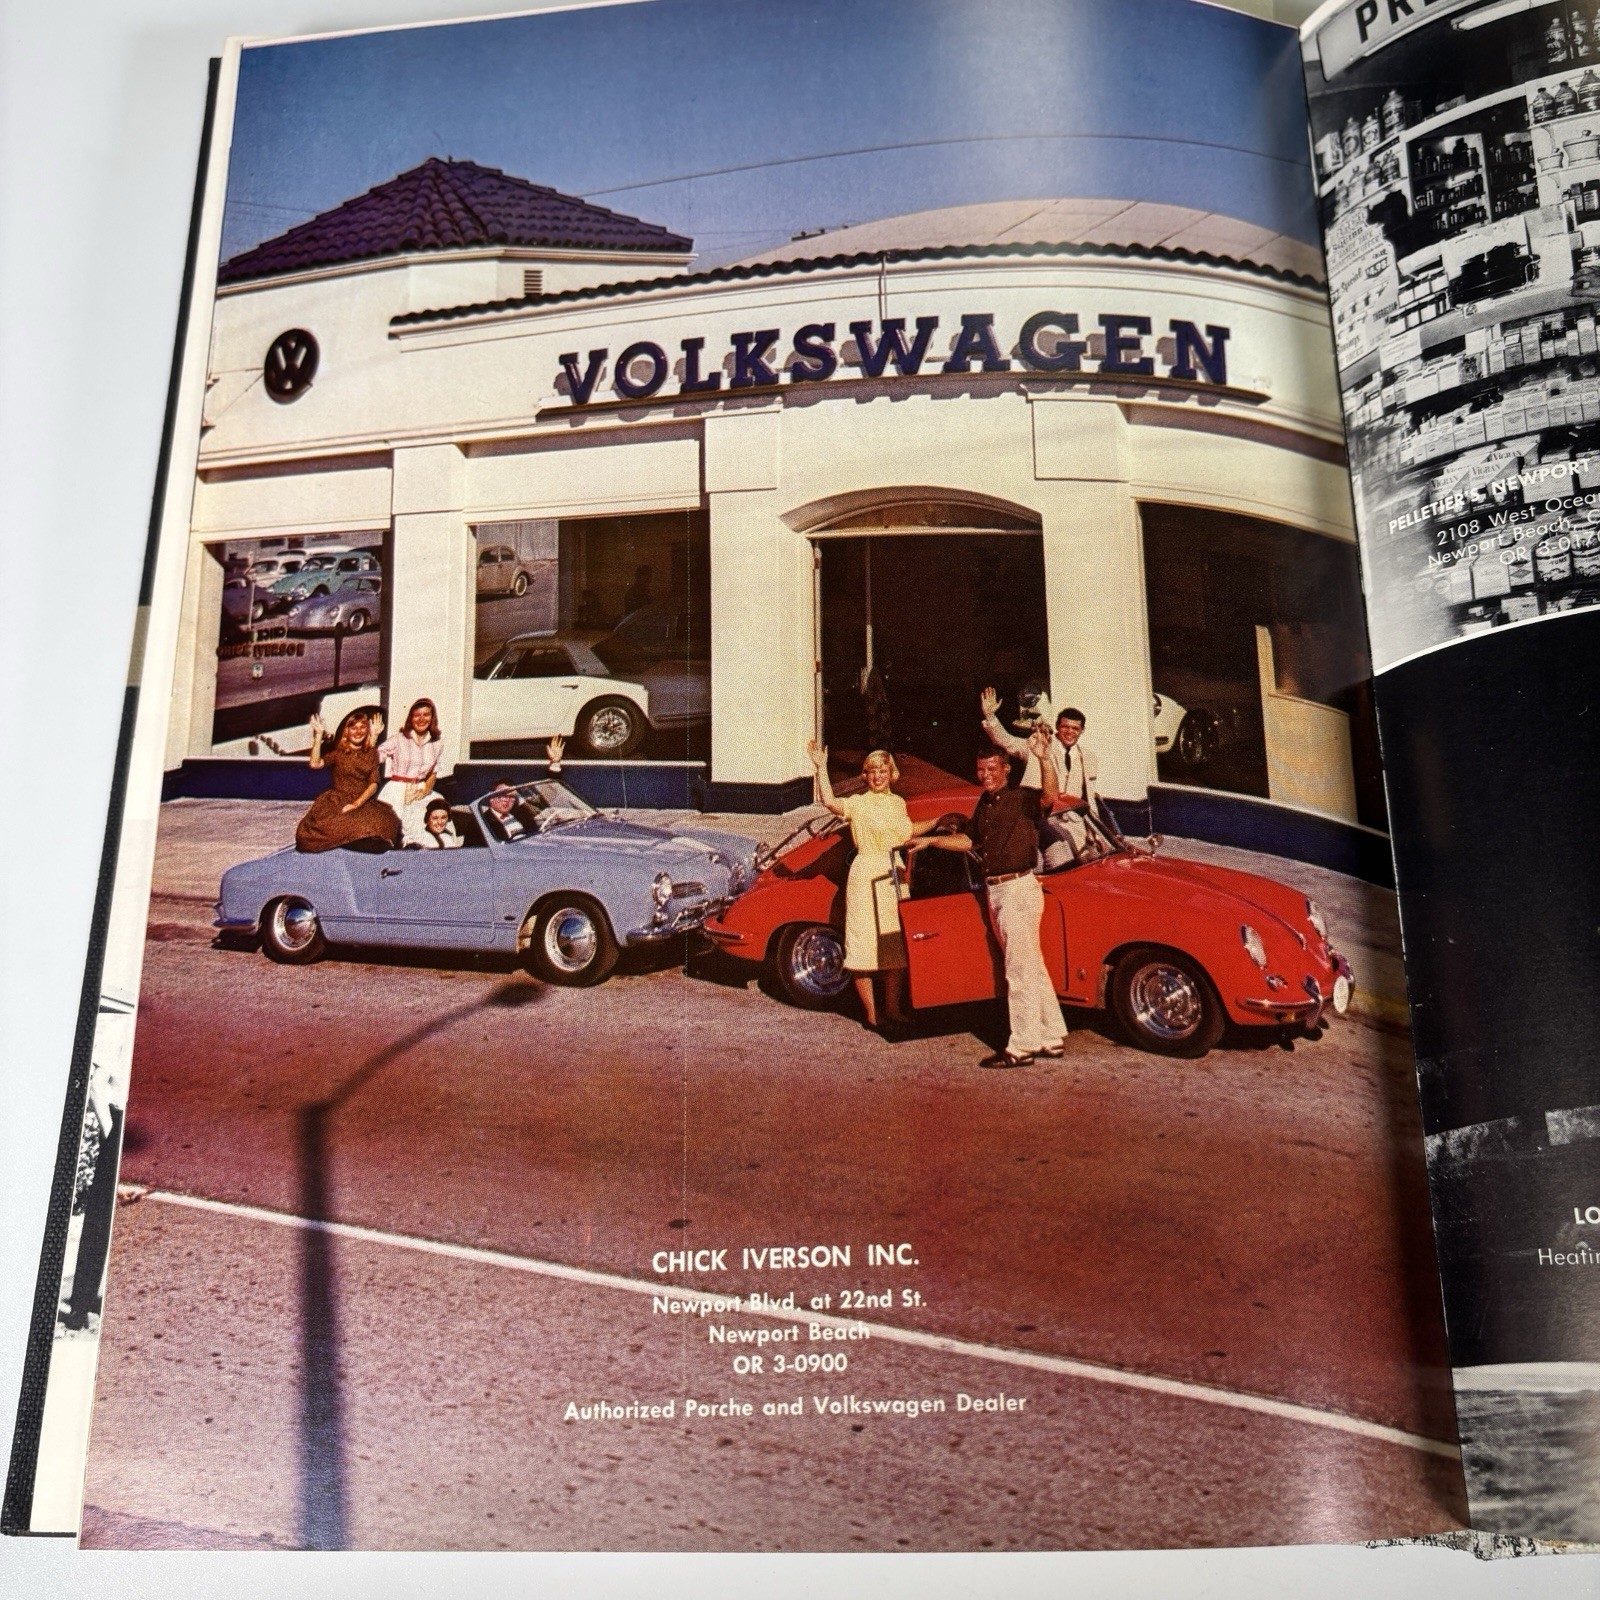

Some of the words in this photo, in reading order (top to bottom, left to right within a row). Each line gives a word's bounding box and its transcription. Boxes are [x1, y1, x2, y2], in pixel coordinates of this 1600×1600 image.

[1355, 0, 1440, 44] PR
[558, 311, 1231, 405] VOLKSWAGEN
[1389, 487, 1480, 535] PELLETIER'S
[1491, 458, 1591, 495] NEWPORT
[1436, 519, 1481, 546] 2108
[1488, 505, 1536, 527] West
[1545, 493, 1600, 512] Ocea
[1428, 534, 1506, 568] Newport
[1513, 516, 1577, 542] Beach,
[1500, 547, 1528, 565] OR
[1538, 530, 1600, 555] 3-017
[652, 1249, 728, 1274] CHICK
[743, 1245, 851, 1270] IVERSON
[867, 1243, 920, 1266] INC.
[653, 1296, 742, 1317] Newport
[749, 1292, 802, 1313] Blvd.
[810, 1294, 833, 1310] at
[839, 1289, 893, 1309] 22nd
[901, 1289, 927, 1307] St.
[708, 1325, 799, 1346] Newport
[808, 1321, 871, 1341] Beach
[733, 1355, 764, 1374] OR
[773, 1353, 848, 1374] 3-0900
[563, 1399, 675, 1420] Authorized
[685, 1398, 754, 1418] Porche
[762, 1396, 803, 1416] and
[813, 1394, 946, 1418] Volkswagen
[956, 1392, 1027, 1412] Dealer
